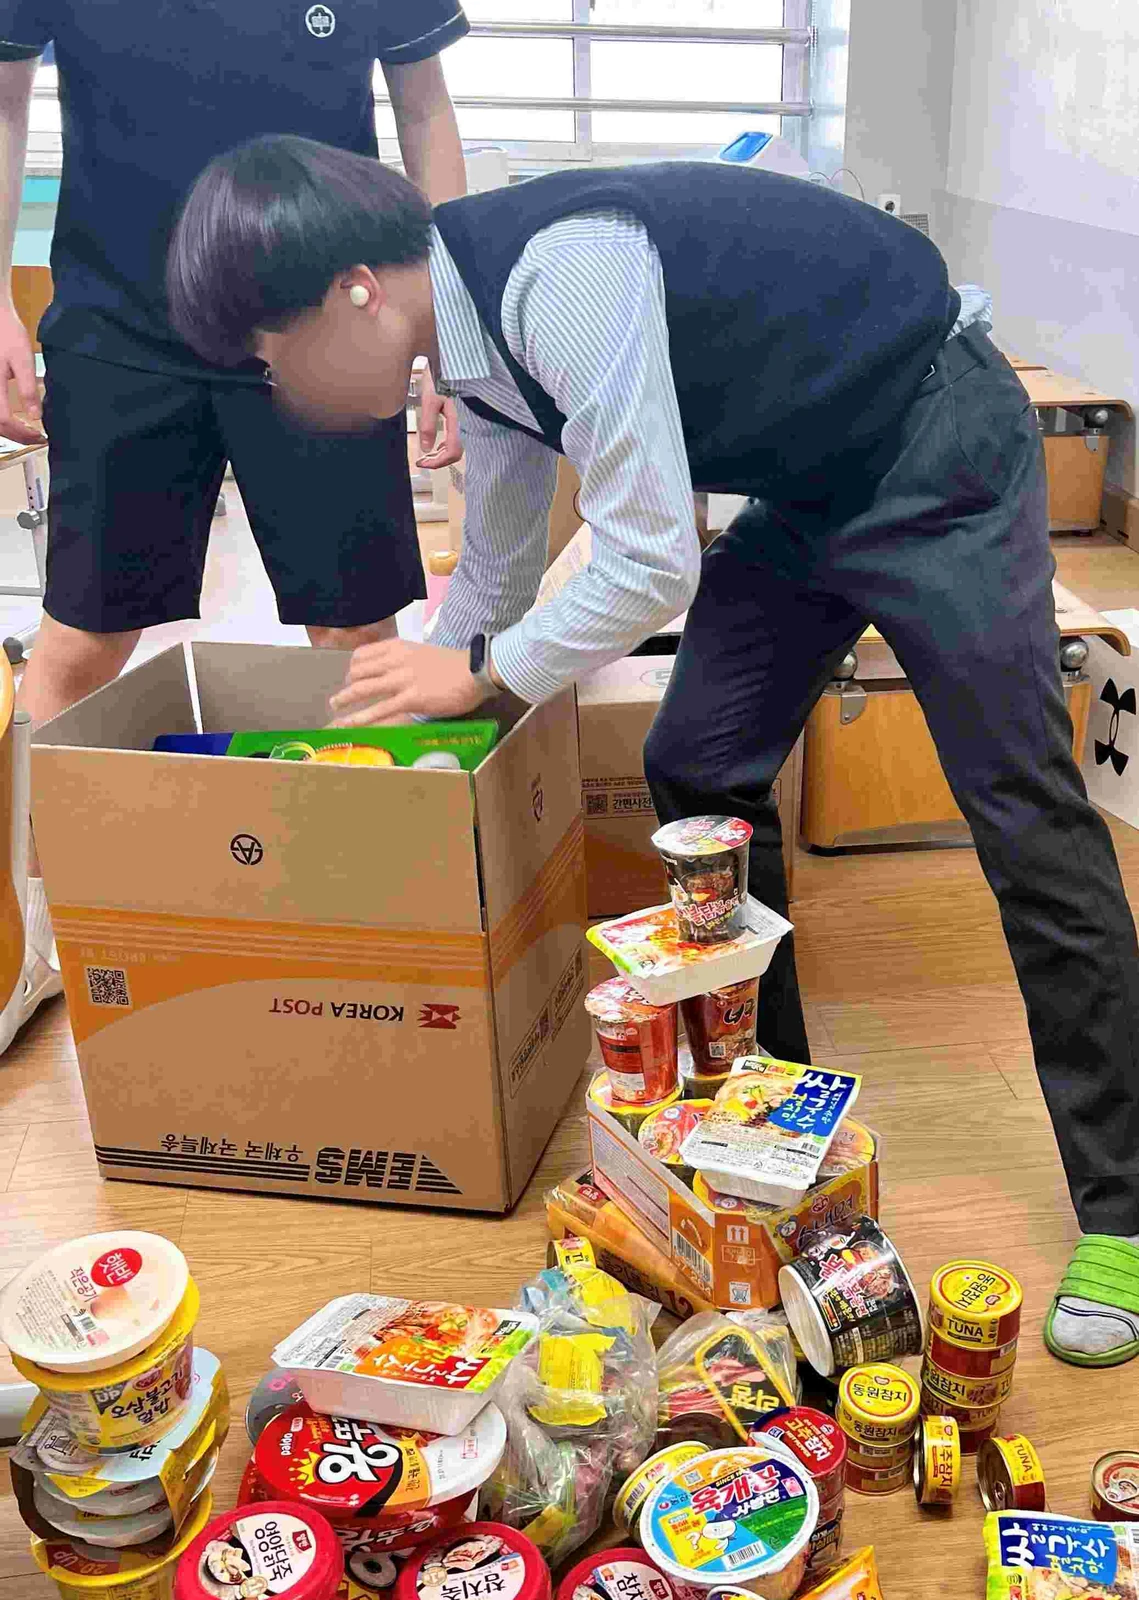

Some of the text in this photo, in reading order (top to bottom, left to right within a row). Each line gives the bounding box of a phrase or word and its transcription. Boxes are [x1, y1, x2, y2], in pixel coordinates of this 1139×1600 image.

[612, 797, 655, 810] 간편사전
[268, 998, 404, 1022] KOREA POST
[796, 1069, 848, 1130] 쌀국수
[161, 1133, 304, 1163] 우체국 국제특송
[314, 1147, 418, 1191] EMS
[98, 1252, 135, 1285] 햇반
[69, 1265, 100, 1304] 작은공기
[955, 1273, 996, 1309] 동원참치
[947, 1317, 984, 1337] TUNA
[97, 1388, 121, 1403] UP
[111, 1370, 183, 1419] 오삼불고기
[852, 1382, 908, 1403] 동원참치
[927, 1367, 966, 1396] 원참치
[280, 1432, 294, 1456] paldo
[784, 1416, 831, 1462] 고추참치
[853, 1421, 897, 1438] 동원참치
[318, 1416, 402, 1485] 왕뚜
[1013, 1442, 1033, 1473] TUNA
[691, 1464, 781, 1515] 육개장
[731, 1487, 781, 1518] 사발면
[254, 1520, 294, 1582] 영양닭죽
[1001, 1522, 1110, 1572] 쌀국수
[1045, 1554, 1105, 1576] 멸치맛
